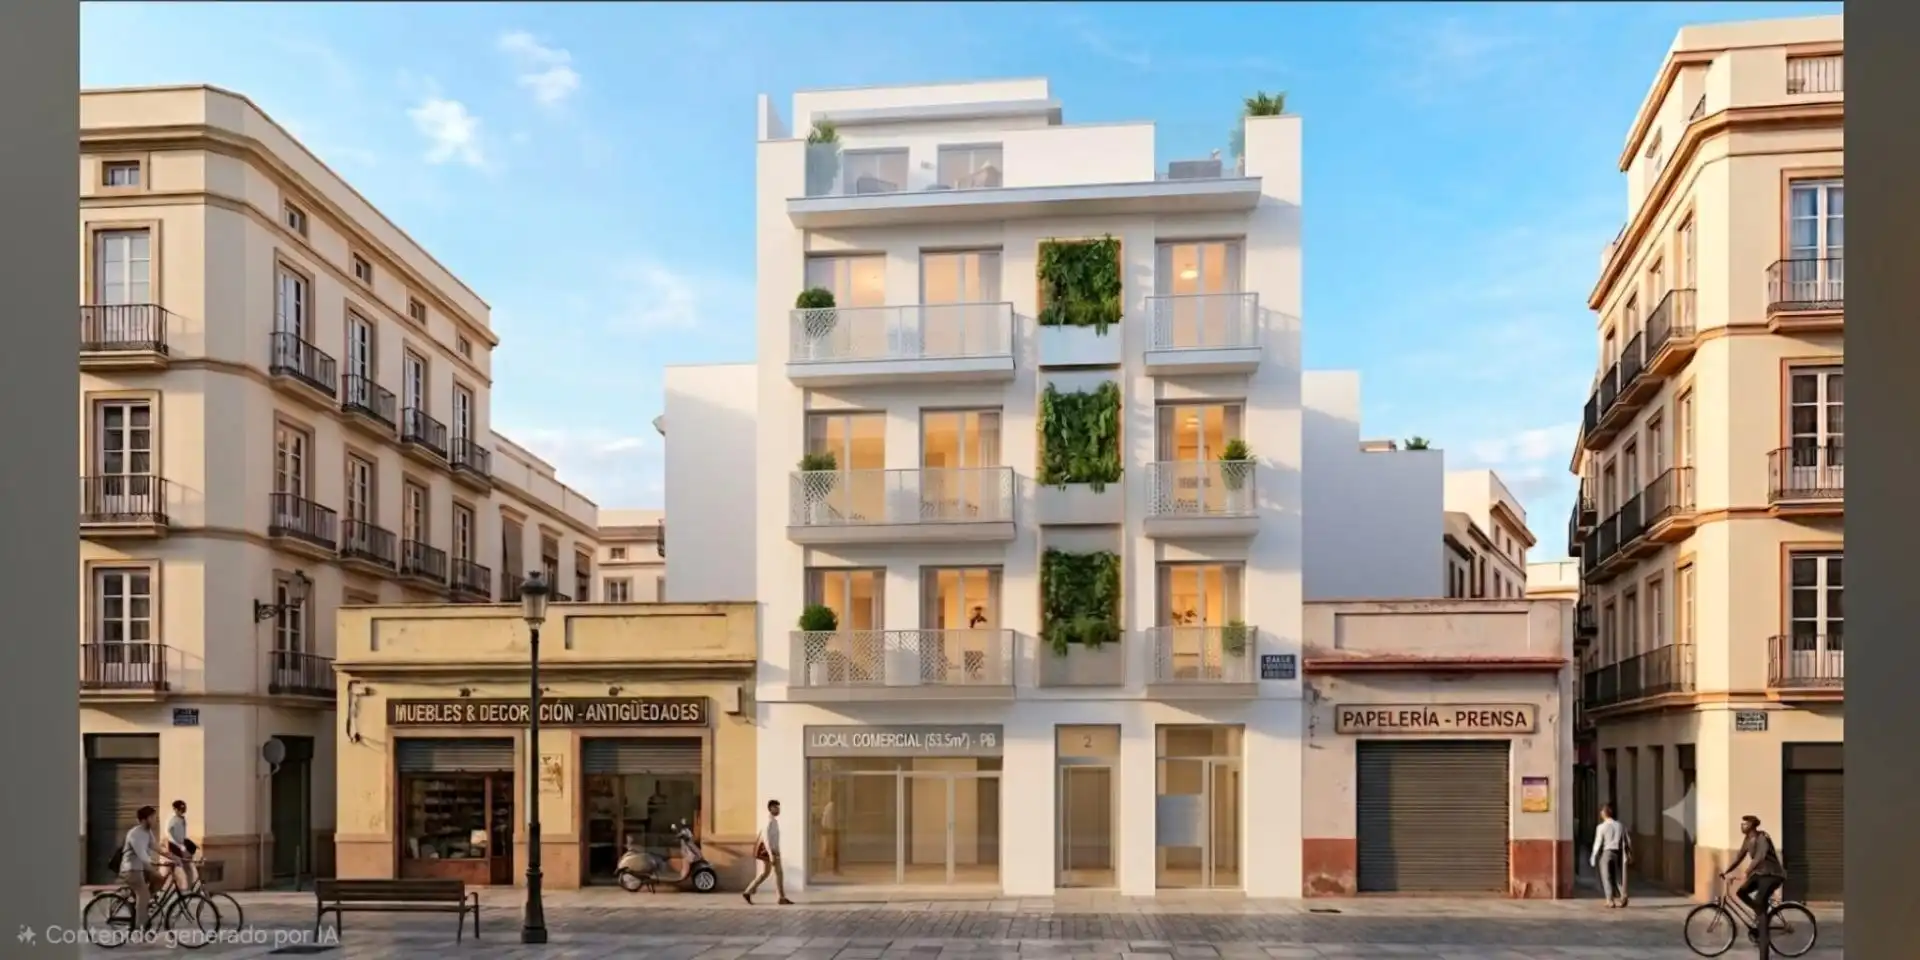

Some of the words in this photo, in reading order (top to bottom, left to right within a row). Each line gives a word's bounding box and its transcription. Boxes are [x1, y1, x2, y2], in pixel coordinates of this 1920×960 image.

[395, 704, 462, 721] MUEBLES
[466, 704, 475, 721] &
[480, 700, 573, 722] DECORCIÓN
[1343, 707, 1440, 727] PAPELERÍA
[1456, 711, 1527, 727] PRENSA
[812, 733, 849, 747] LOCAL
[853, 733, 922, 747] COMERCIAL
[1083, 734, 1092, 748] 2
